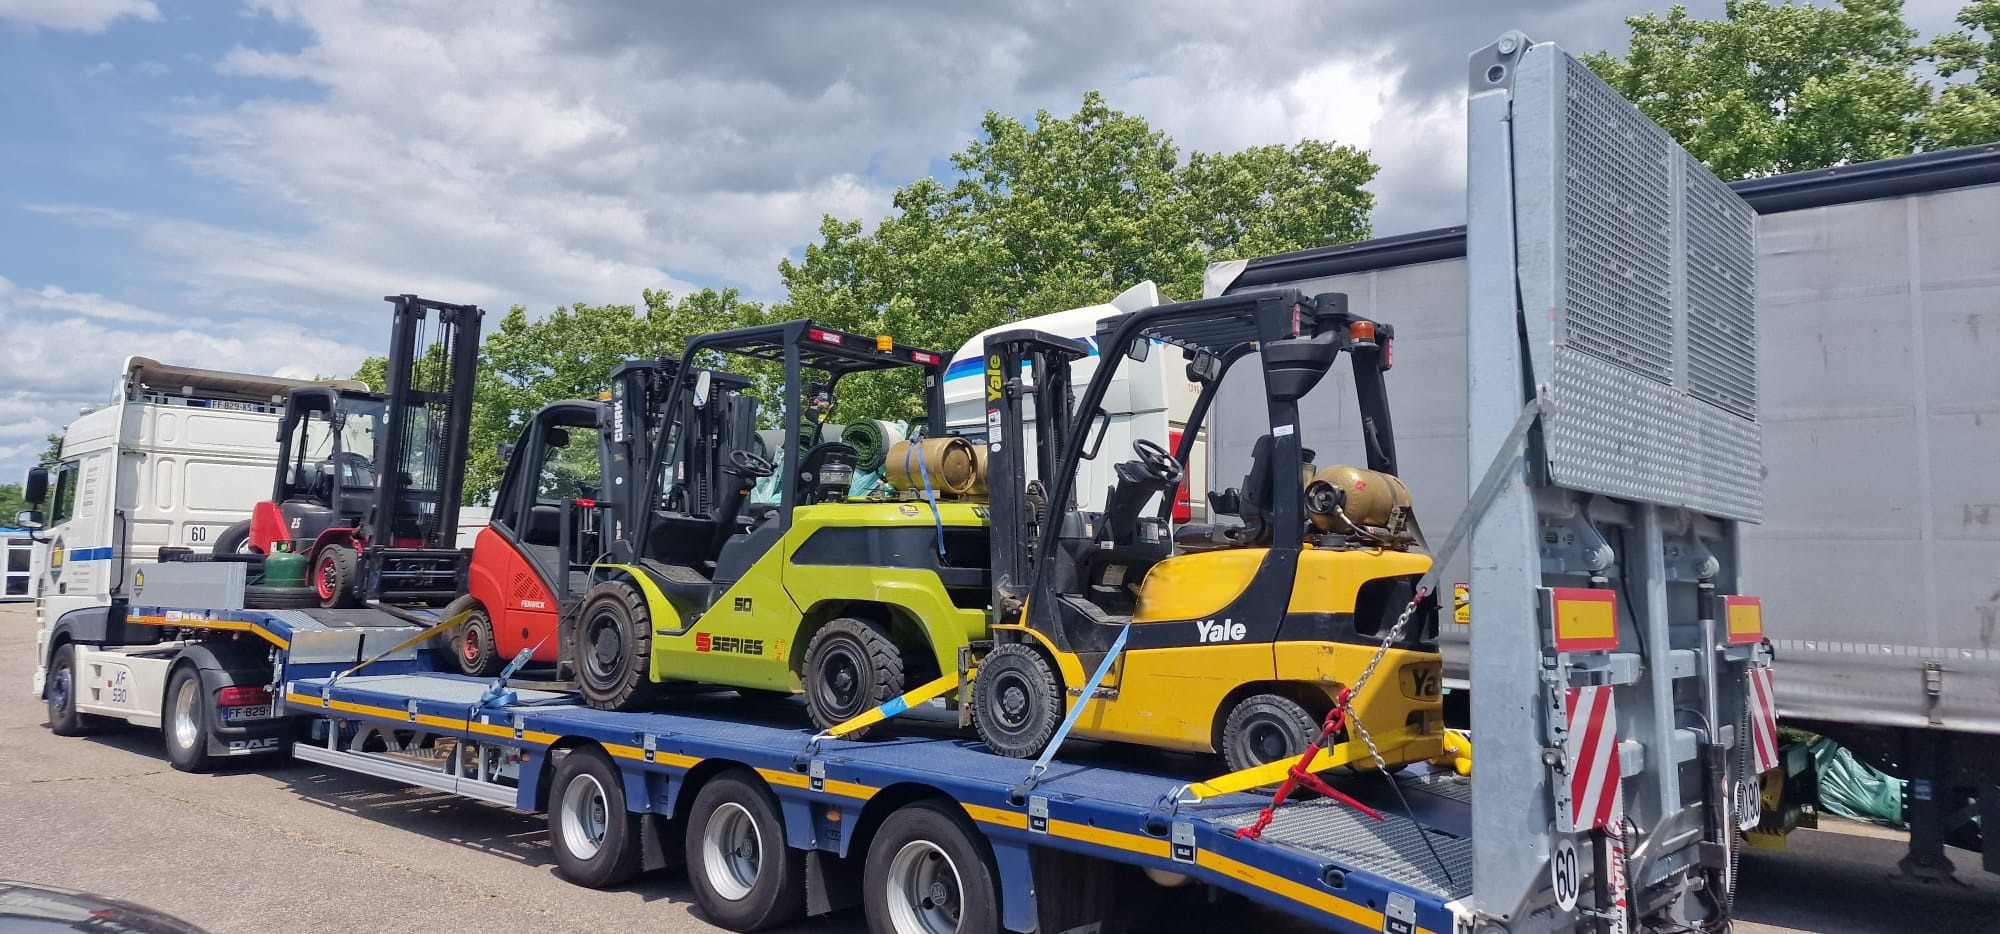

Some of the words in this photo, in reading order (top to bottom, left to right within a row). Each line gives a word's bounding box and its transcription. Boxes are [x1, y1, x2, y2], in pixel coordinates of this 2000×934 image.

[987, 355, 1002, 402] Yale
[614, 400, 623, 442] CLARK
[191, 527, 206, 541] 60
[734, 597, 752, 612] 50
[1196, 618, 1247, 643] Yale
[712, 636, 764, 655] SERIES
[115, 671, 126, 684] XF
[112, 688, 127, 703] 530
[229, 738, 279, 750] DAF
[1556, 847, 1576, 903] 60
